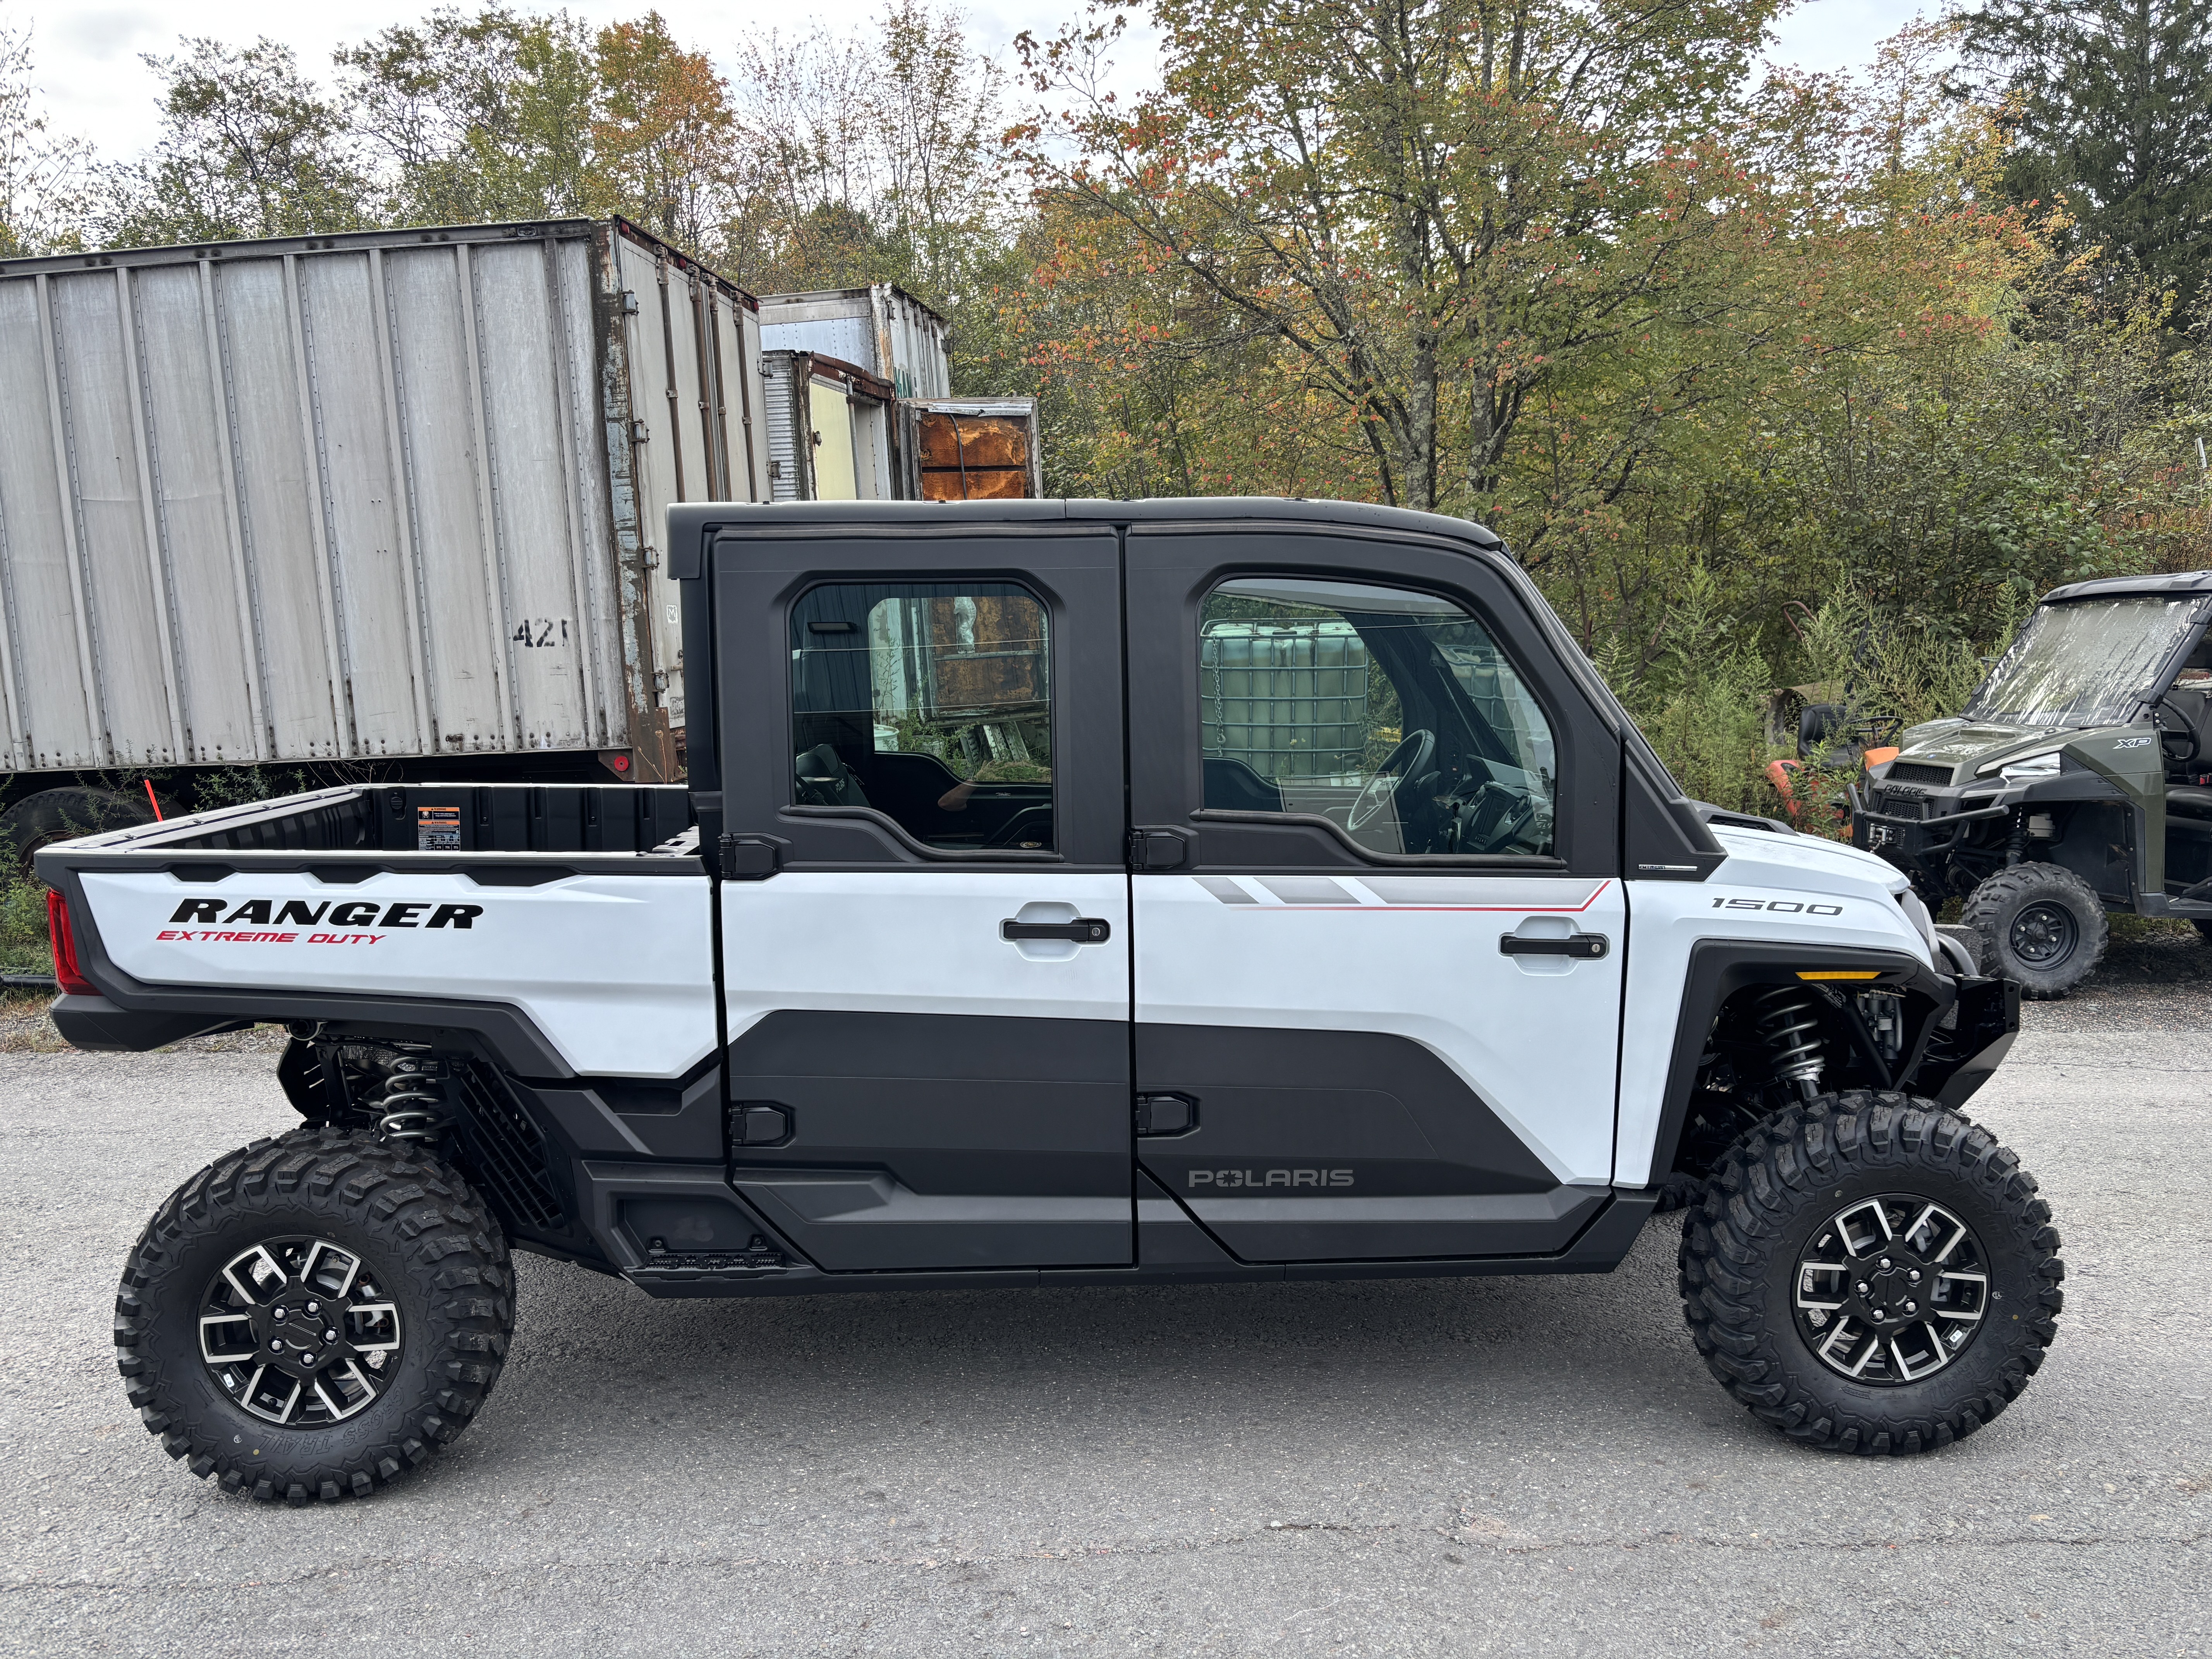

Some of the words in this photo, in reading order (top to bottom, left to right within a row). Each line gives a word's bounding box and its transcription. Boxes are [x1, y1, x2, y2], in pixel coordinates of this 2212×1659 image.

[513, 619, 568, 648] 421
[2112, 737, 2152, 749] XP
[1884, 784, 1928, 799] POLARIS
[168, 898, 484, 929] RANGER
[1712, 898, 1843, 915] 1500
[156, 931, 299, 943] EXTREME
[308, 934, 386, 945] DUTY
[1188, 1170, 1355, 1187] POLARIS
[1985, 1268, 2017, 1348] CROSS
[1921, 1349, 1989, 1401] TRAIL
[343, 1384, 405, 1448] CROSS
[258, 1431, 335, 1456] TRAIL
